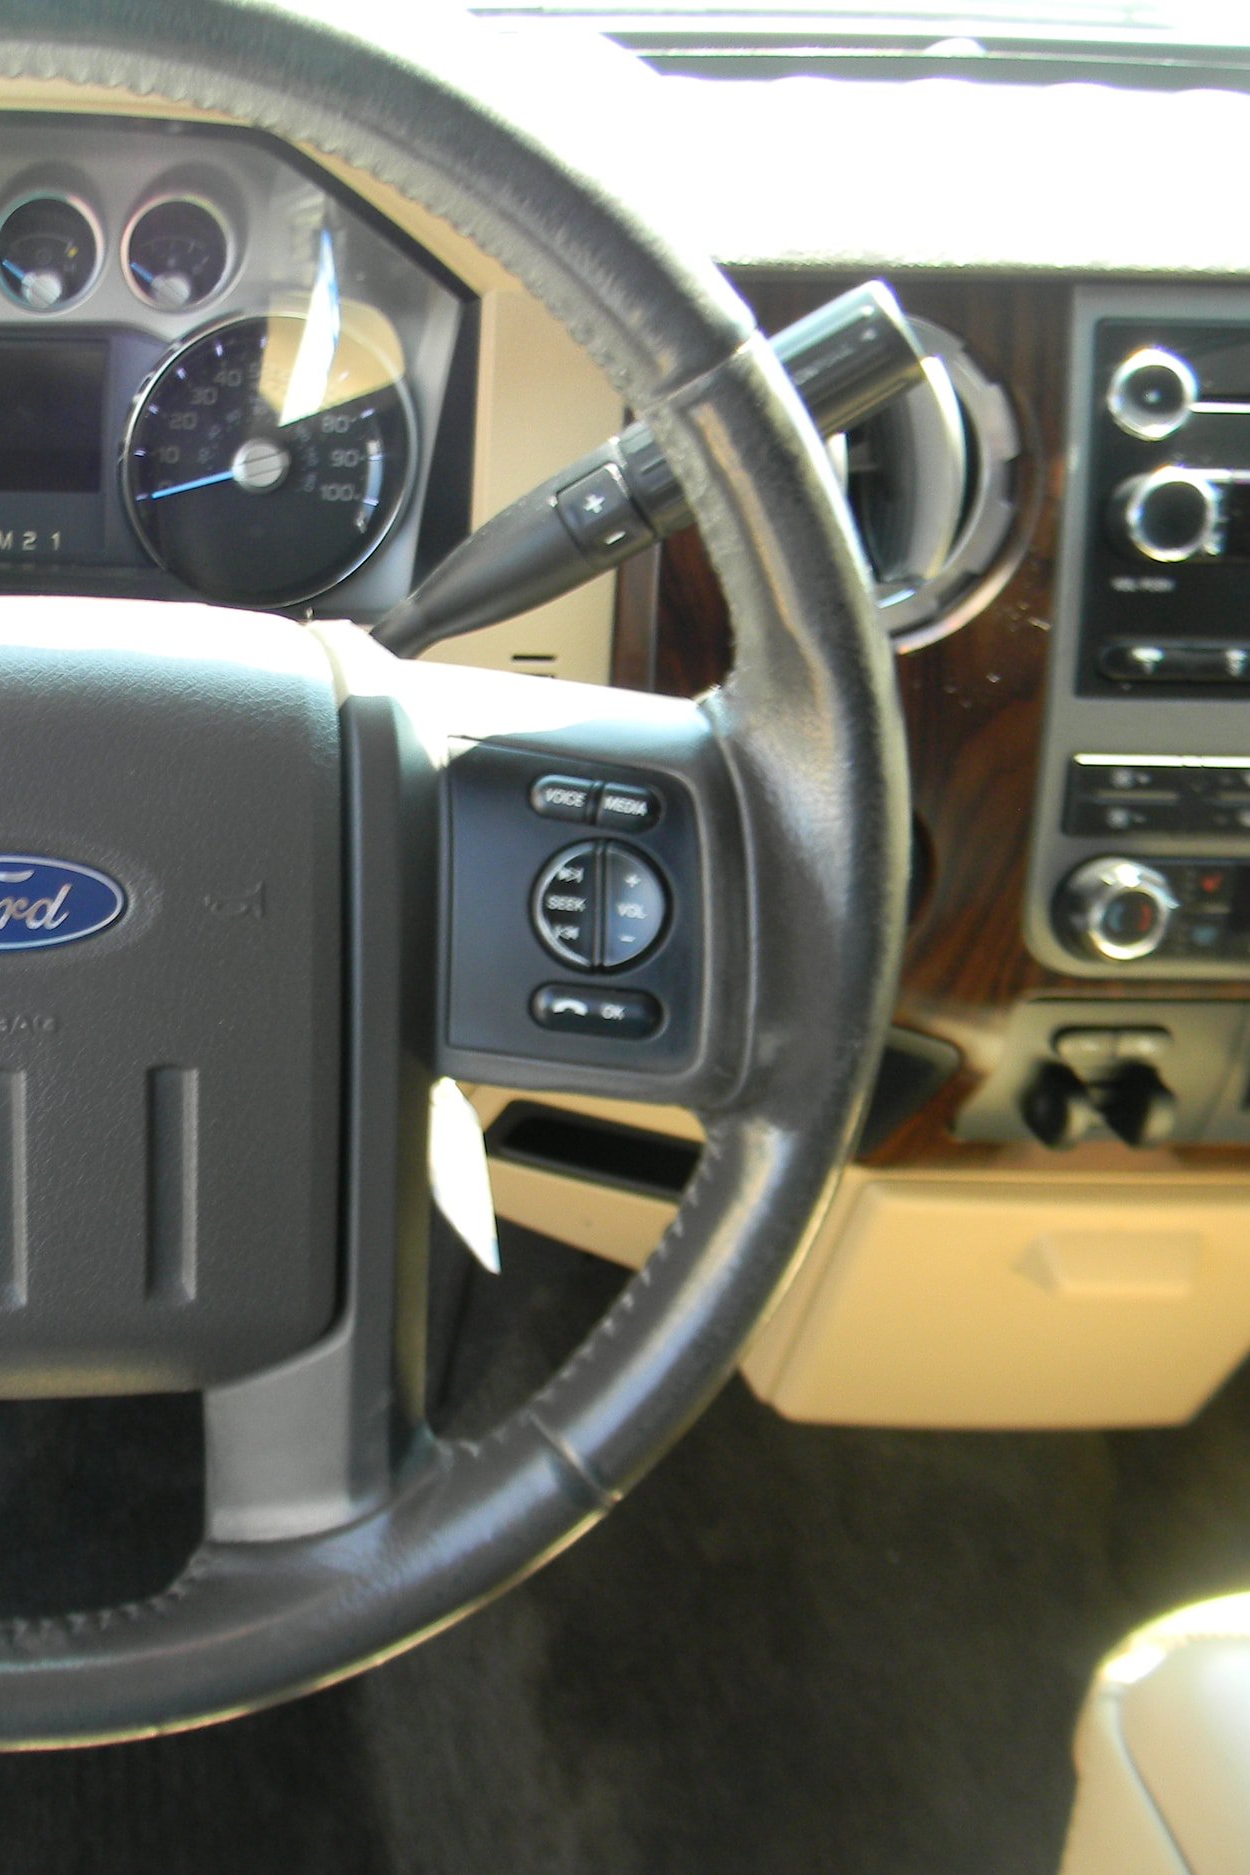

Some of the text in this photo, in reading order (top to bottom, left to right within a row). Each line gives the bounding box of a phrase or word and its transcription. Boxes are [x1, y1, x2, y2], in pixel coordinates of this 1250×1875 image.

[22, 531, 37, 550] 2
[545, 788, 586, 808] VOICE
[604, 797, 648, 816] MEDIA
[547, 895, 586, 912] SEEK
[617, 903, 647, 919] VOL
[601, 1004, 626, 1020] OK
